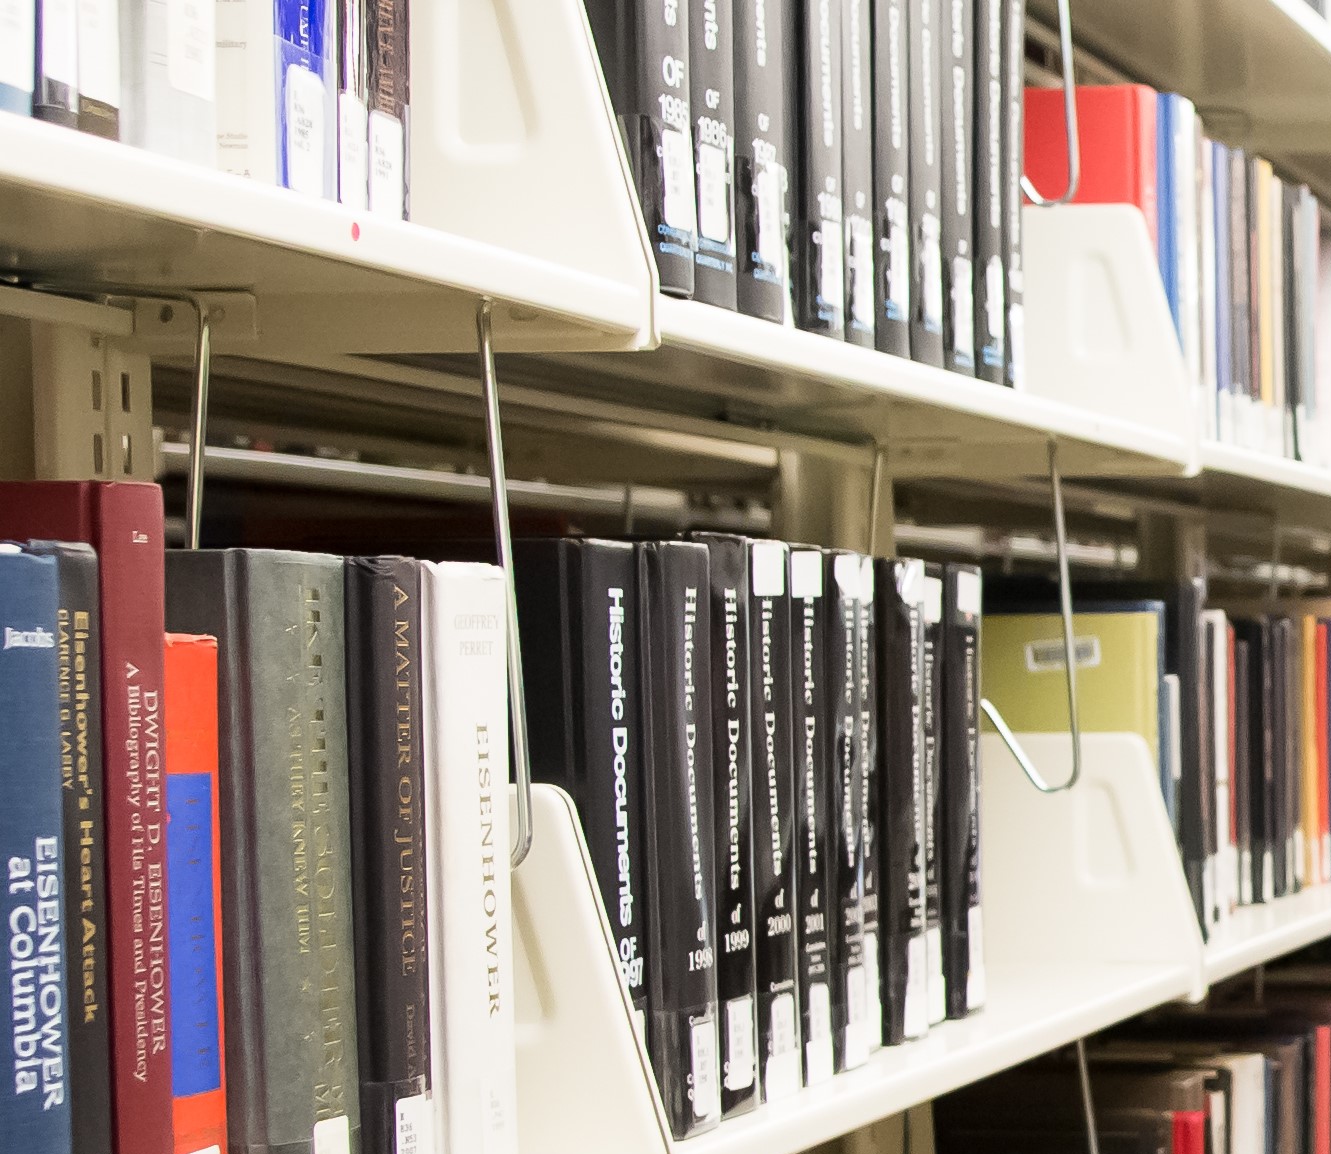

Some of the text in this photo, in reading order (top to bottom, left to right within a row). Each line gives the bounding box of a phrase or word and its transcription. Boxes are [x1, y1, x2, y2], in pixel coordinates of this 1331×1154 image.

[663, 55, 685, 88] OF
[125, 661, 140, 679] A
[454, 614, 500, 632] GEOFFREY
[459, 641, 495, 657] PERRET
[607, 587, 628, 721] Historic
[724, 587, 740, 708] Historic
[126, 684, 143, 807] Bibliography
[393, 582, 418, 977] A MATTER OF JUSTICE
[684, 586, 702, 900] Historic Documents
[74, 611, 99, 1024] Eisenhower's Heart Attack
[131, 812, 144, 833] of
[612, 727, 634, 927] Documents
[727, 718, 742, 891] Documents
[132, 874, 145, 934] Times
[144, 690, 167, 1055] DWIGHT D. EISENHOWER
[476, 722, 501, 1019] EISENHOWER
[766, 912, 792, 937] 2000
[8, 856, 44, 1095] at Columbia
[35, 835, 65, 1111] EISENHOWER
[133, 938, 148, 975] and
[620, 957, 645, 989] 997
[724, 928, 751, 954] 1999
[133, 978, 150, 1084] Presidency
